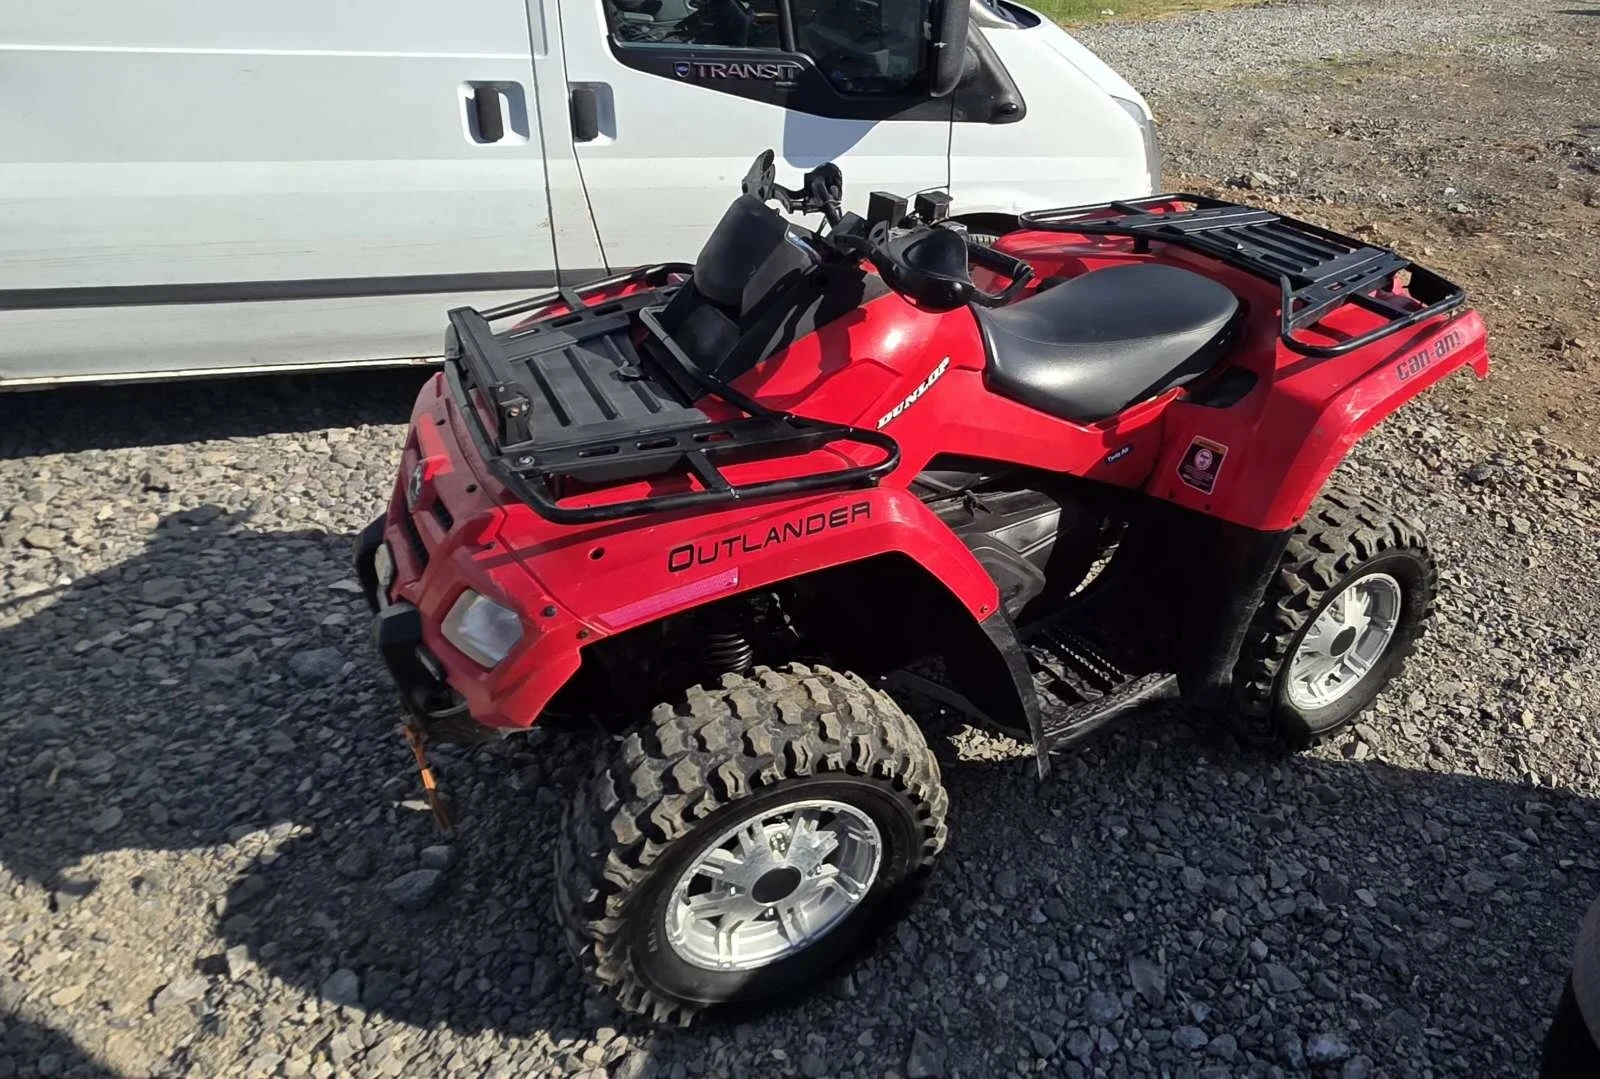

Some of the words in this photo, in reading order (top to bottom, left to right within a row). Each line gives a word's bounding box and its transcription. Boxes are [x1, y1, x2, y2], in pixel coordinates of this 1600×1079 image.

[693, 62, 799, 80] TRANSIT
[876, 356, 950, 430] DUNLOP
[668, 502, 871, 573] OUTLANDER
